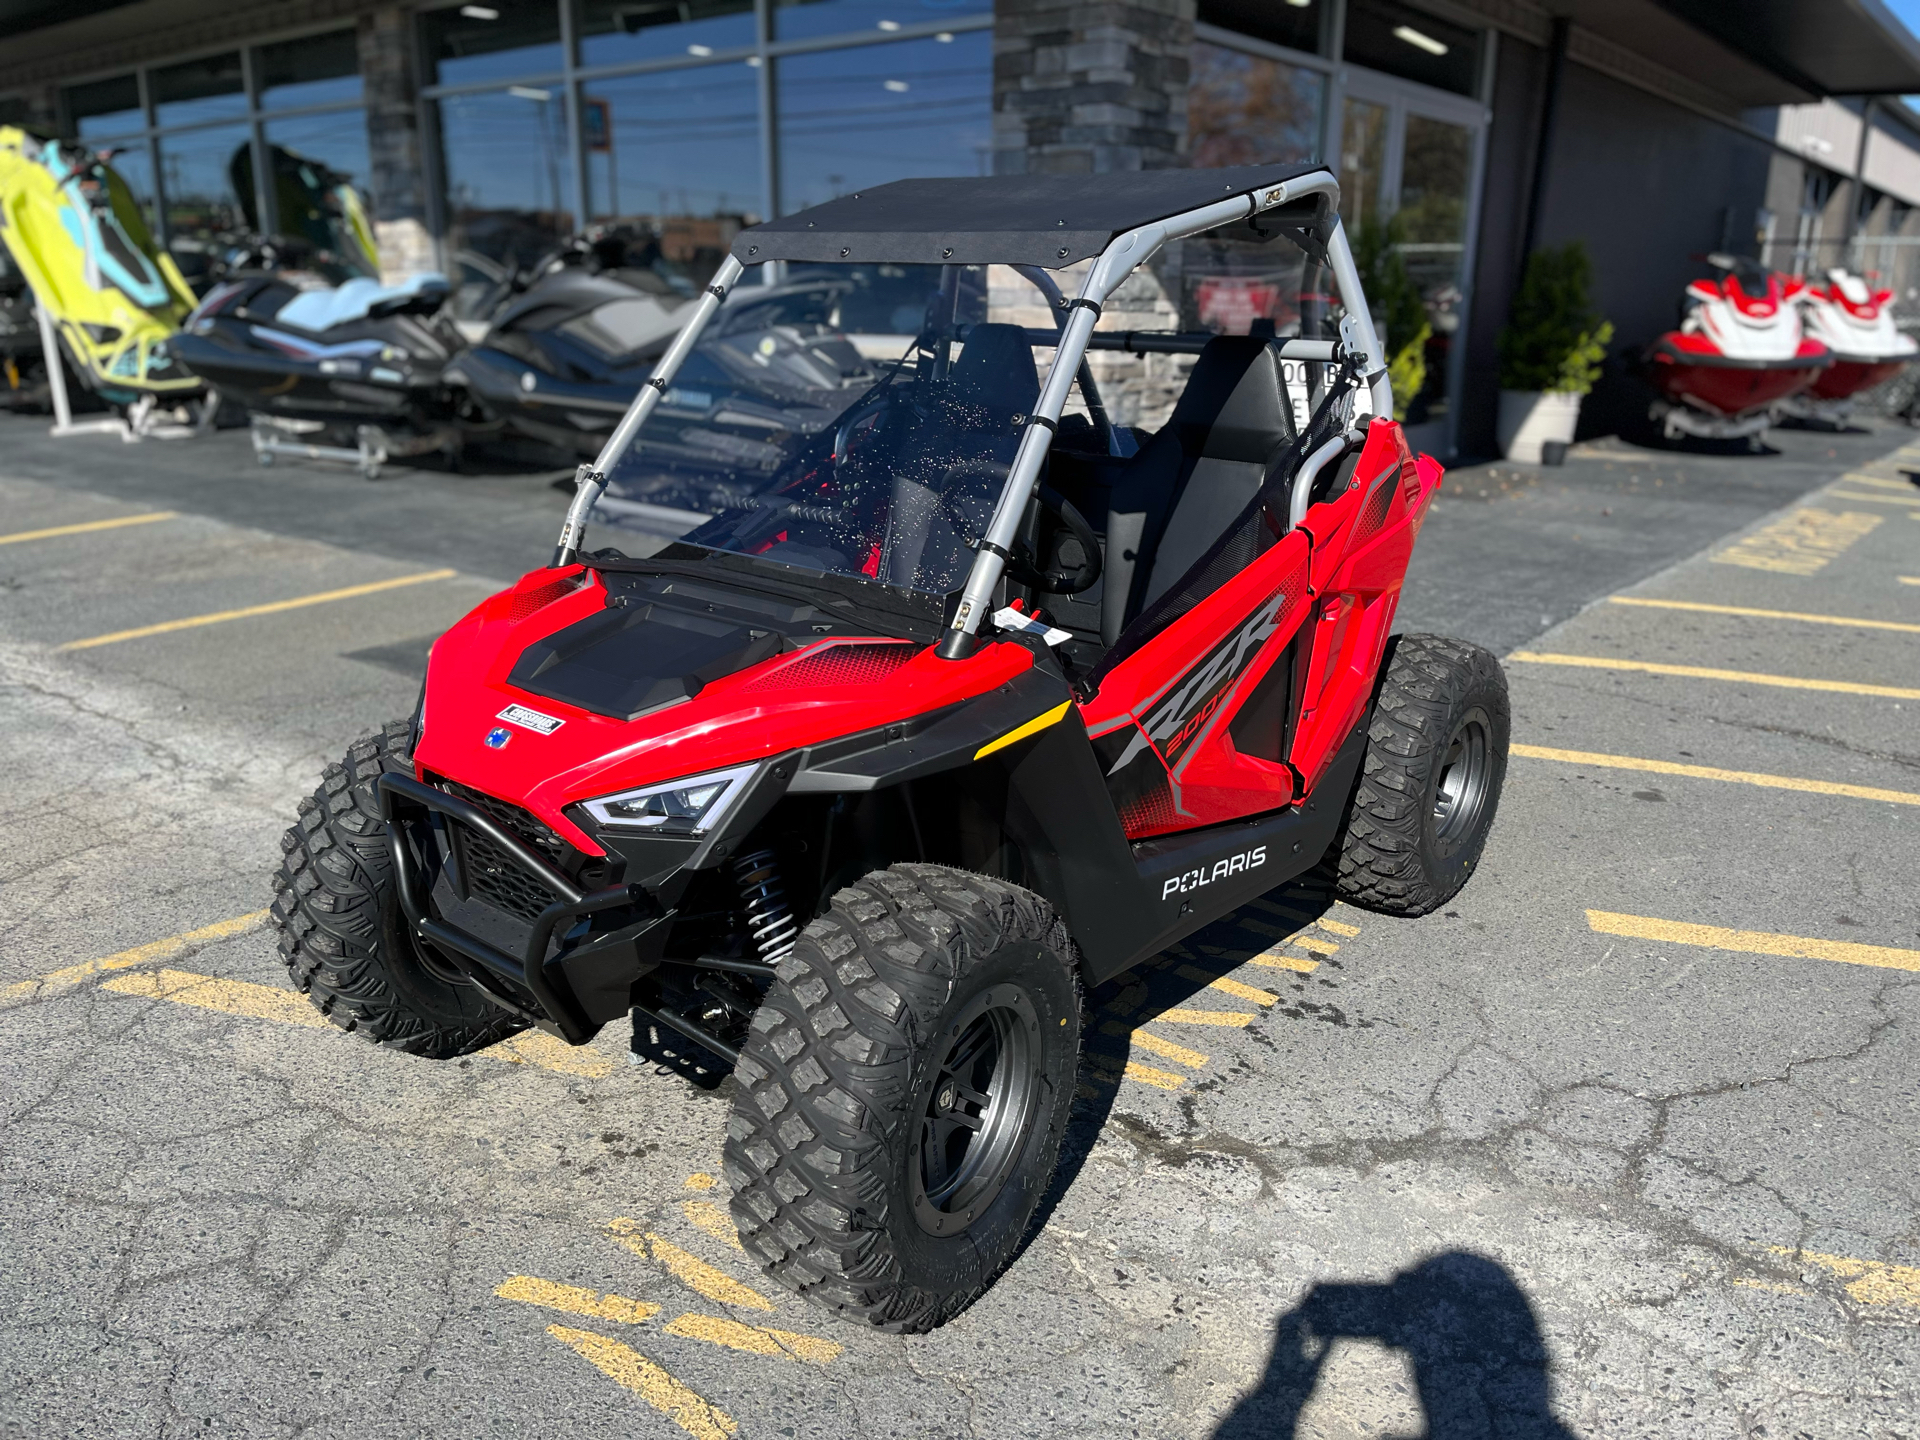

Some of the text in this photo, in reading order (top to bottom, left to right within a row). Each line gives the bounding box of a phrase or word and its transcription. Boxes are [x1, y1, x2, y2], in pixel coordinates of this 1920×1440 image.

[1106, 594, 1286, 777] RZR
[1165, 694, 1219, 759] 200
[1162, 845, 1267, 901] POLARIS
